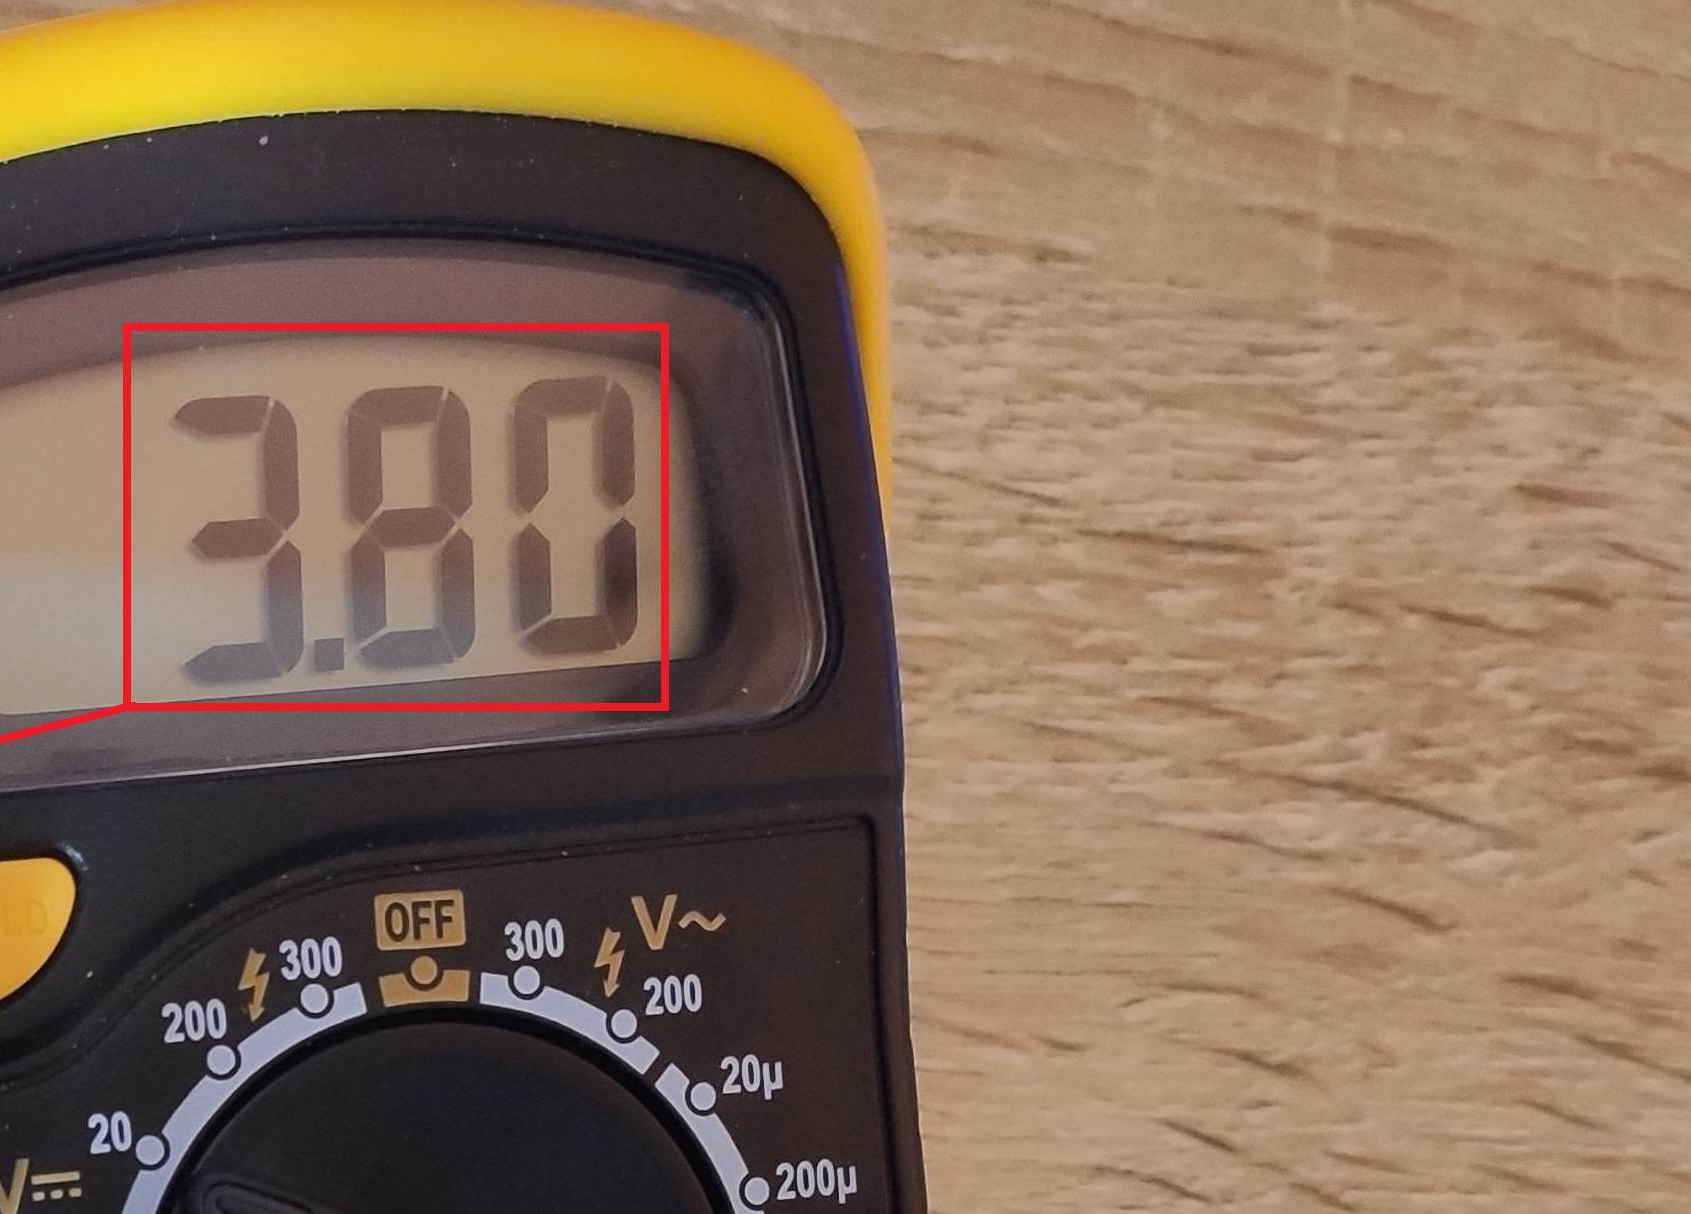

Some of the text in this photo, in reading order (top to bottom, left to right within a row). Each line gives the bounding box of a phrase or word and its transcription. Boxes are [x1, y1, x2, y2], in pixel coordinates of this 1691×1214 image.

[173, 377, 638, 682] 3.80
[384, 900, 454, 941] OFF
[504, 918, 564, 962] 300
[279, 937, 342, 980] 300
[643, 974, 703, 1016] 200
[162, 998, 227, 1043] 200
[720, 1054, 783, 1100] 20µ
[88, 1111, 132, 1154] 20
[775, 1159, 857, 1204] 200µ
